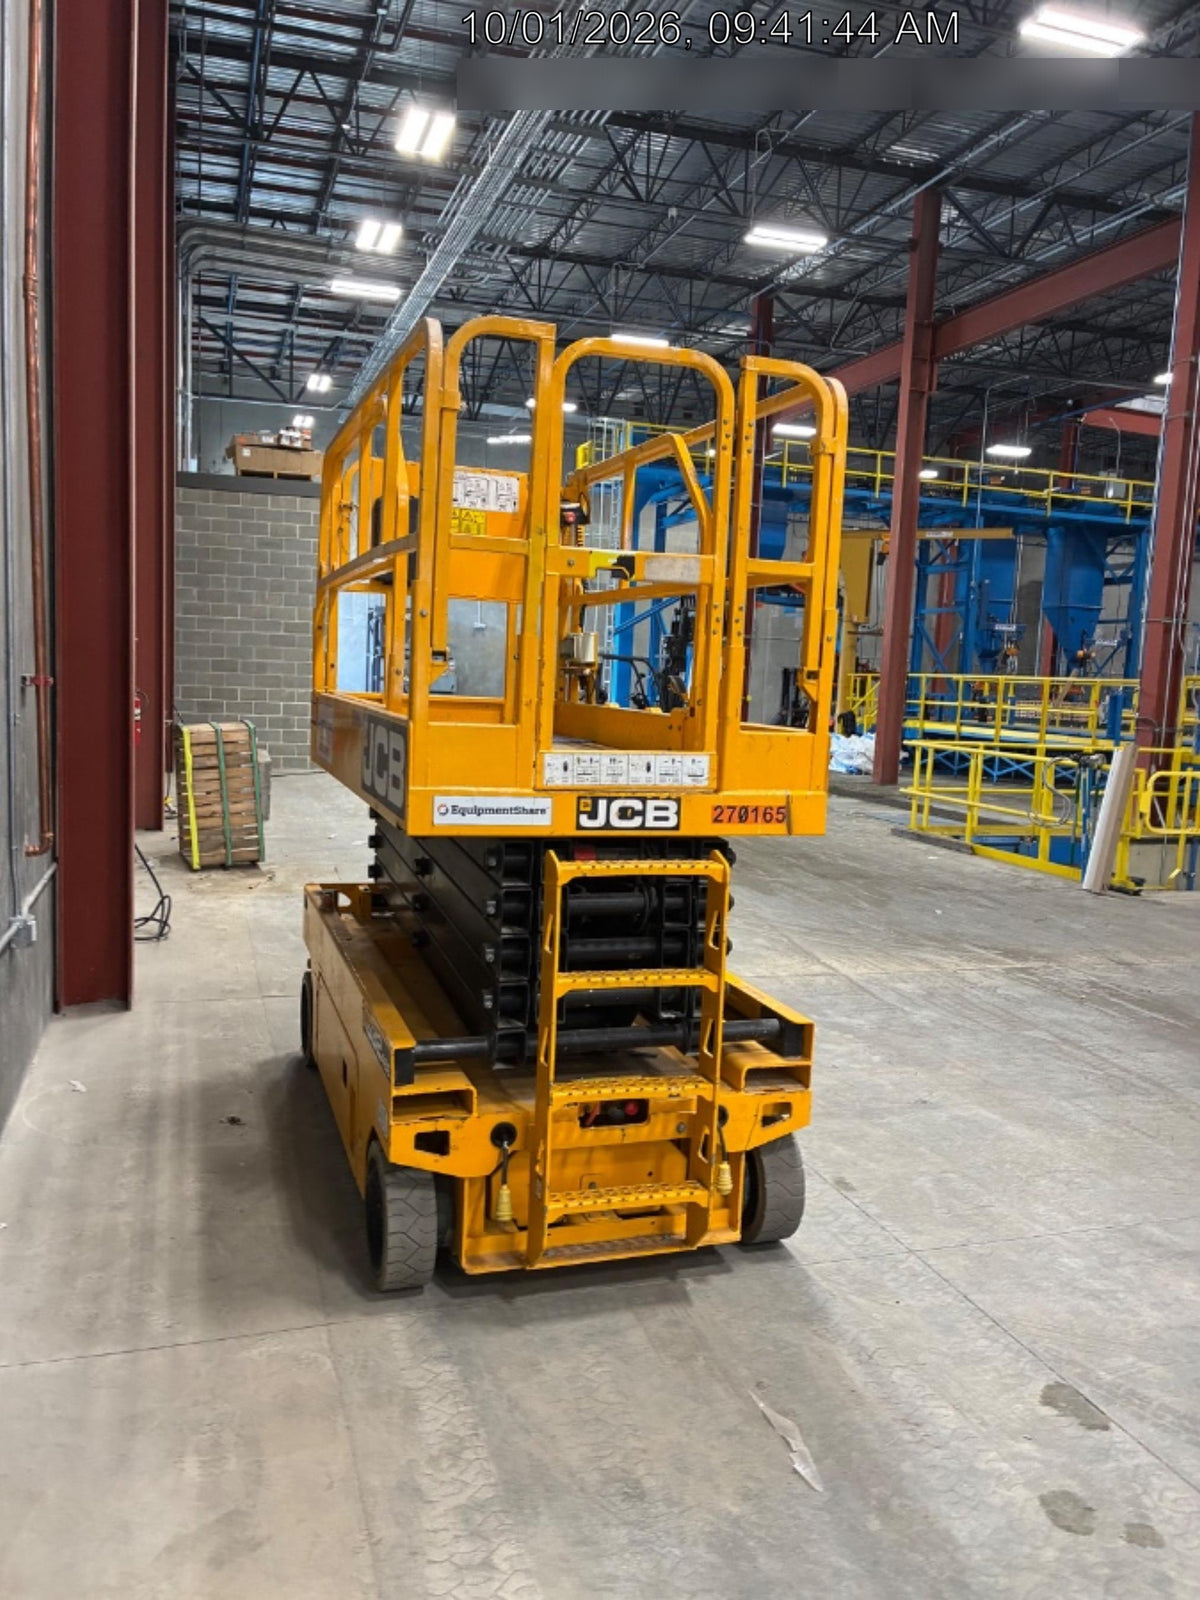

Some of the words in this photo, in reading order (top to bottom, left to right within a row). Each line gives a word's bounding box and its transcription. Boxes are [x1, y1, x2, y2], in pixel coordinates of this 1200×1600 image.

[364, 721, 406, 808] JCB
[450, 804, 547, 817] EquipmentShare
[578, 798, 679, 828] JCB
[712, 805, 787, 824] 270165
